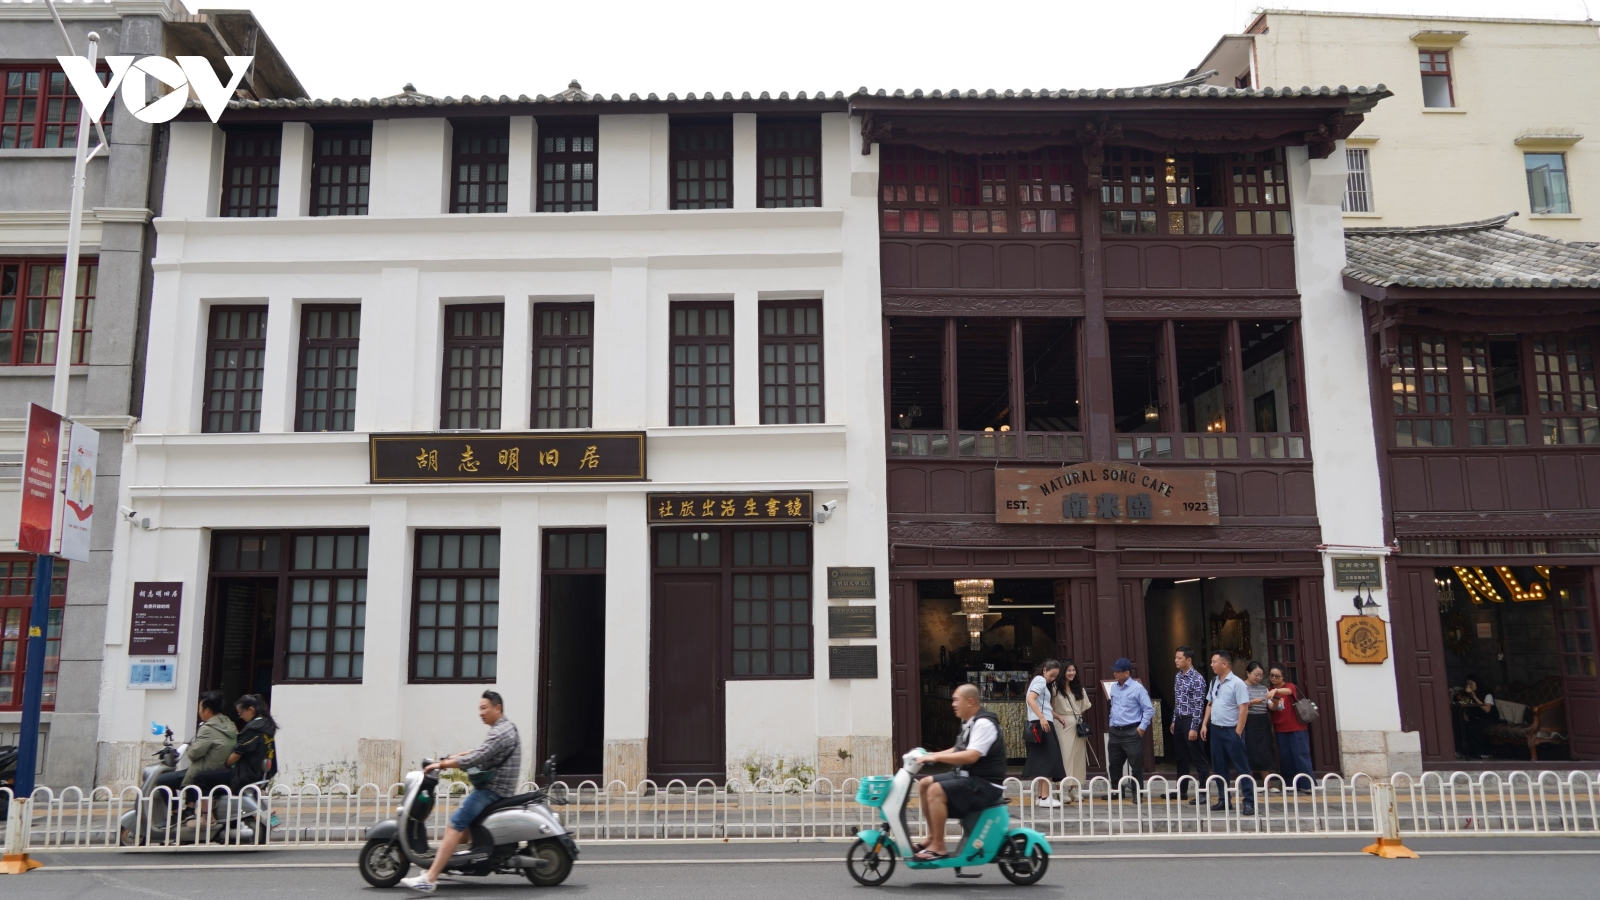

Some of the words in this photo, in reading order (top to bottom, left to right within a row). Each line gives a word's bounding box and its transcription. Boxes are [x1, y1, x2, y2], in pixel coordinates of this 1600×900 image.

[415, 444, 601, 472] 胡志明旧居
[1039, 469, 1098, 497] NATURAL
[1102, 468, 1136, 484] SONG
[1141, 475, 1174, 498] CAFE
[1006, 500, 1030, 510] EST.
[1183, 501, 1209, 512] 1923
[139, 589, 178, 598] 胡志明旧居
